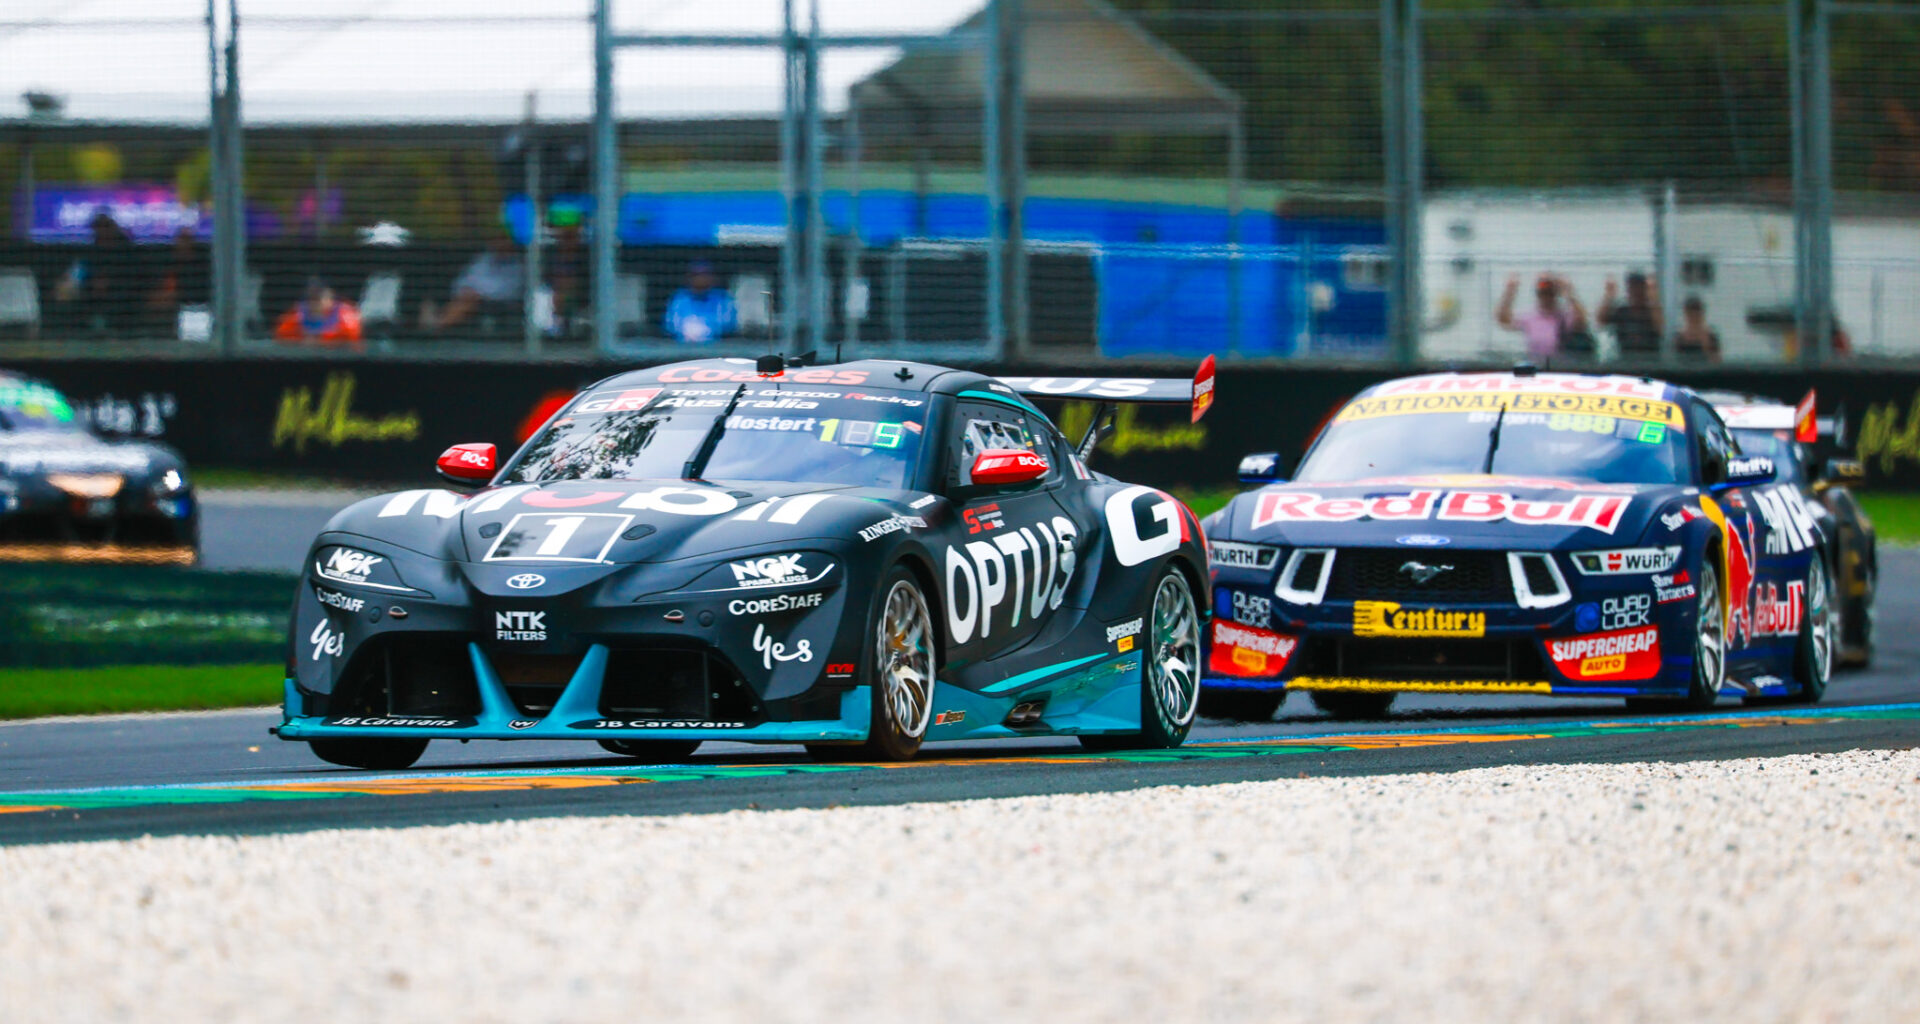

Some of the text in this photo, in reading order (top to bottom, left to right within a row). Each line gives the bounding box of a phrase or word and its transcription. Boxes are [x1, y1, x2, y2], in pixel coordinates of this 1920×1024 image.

[575, 397, 641, 413] GR
[758, 389, 841, 399] GAZOO
[844, 392, 923, 407] Racing
[1349, 393, 1674, 421] NATIONAL STORAGE
[724, 415, 839, 442] Mostert 1
[1549, 412, 1616, 434] 888
[461, 451, 490, 467] BOC
[1018, 456, 1050, 468] BOC
[535, 516, 587, 555] 1
[327, 548, 383, 576] NGK
[730, 553, 807, 580] NGK
[946, 516, 1077, 644] OPTUS
[1602, 594, 1651, 615] QUAD
[496, 611, 547, 631] NTK
[1602, 609, 1650, 631] LOCK
[497, 630, 548, 642] FILTERS
[1551, 630, 1657, 662] SUPERCHEAP
[1586, 659, 1621, 672] AUTO
[332, 717, 458, 728] JB Caravans
[595, 720, 746, 729] JB Caravans
